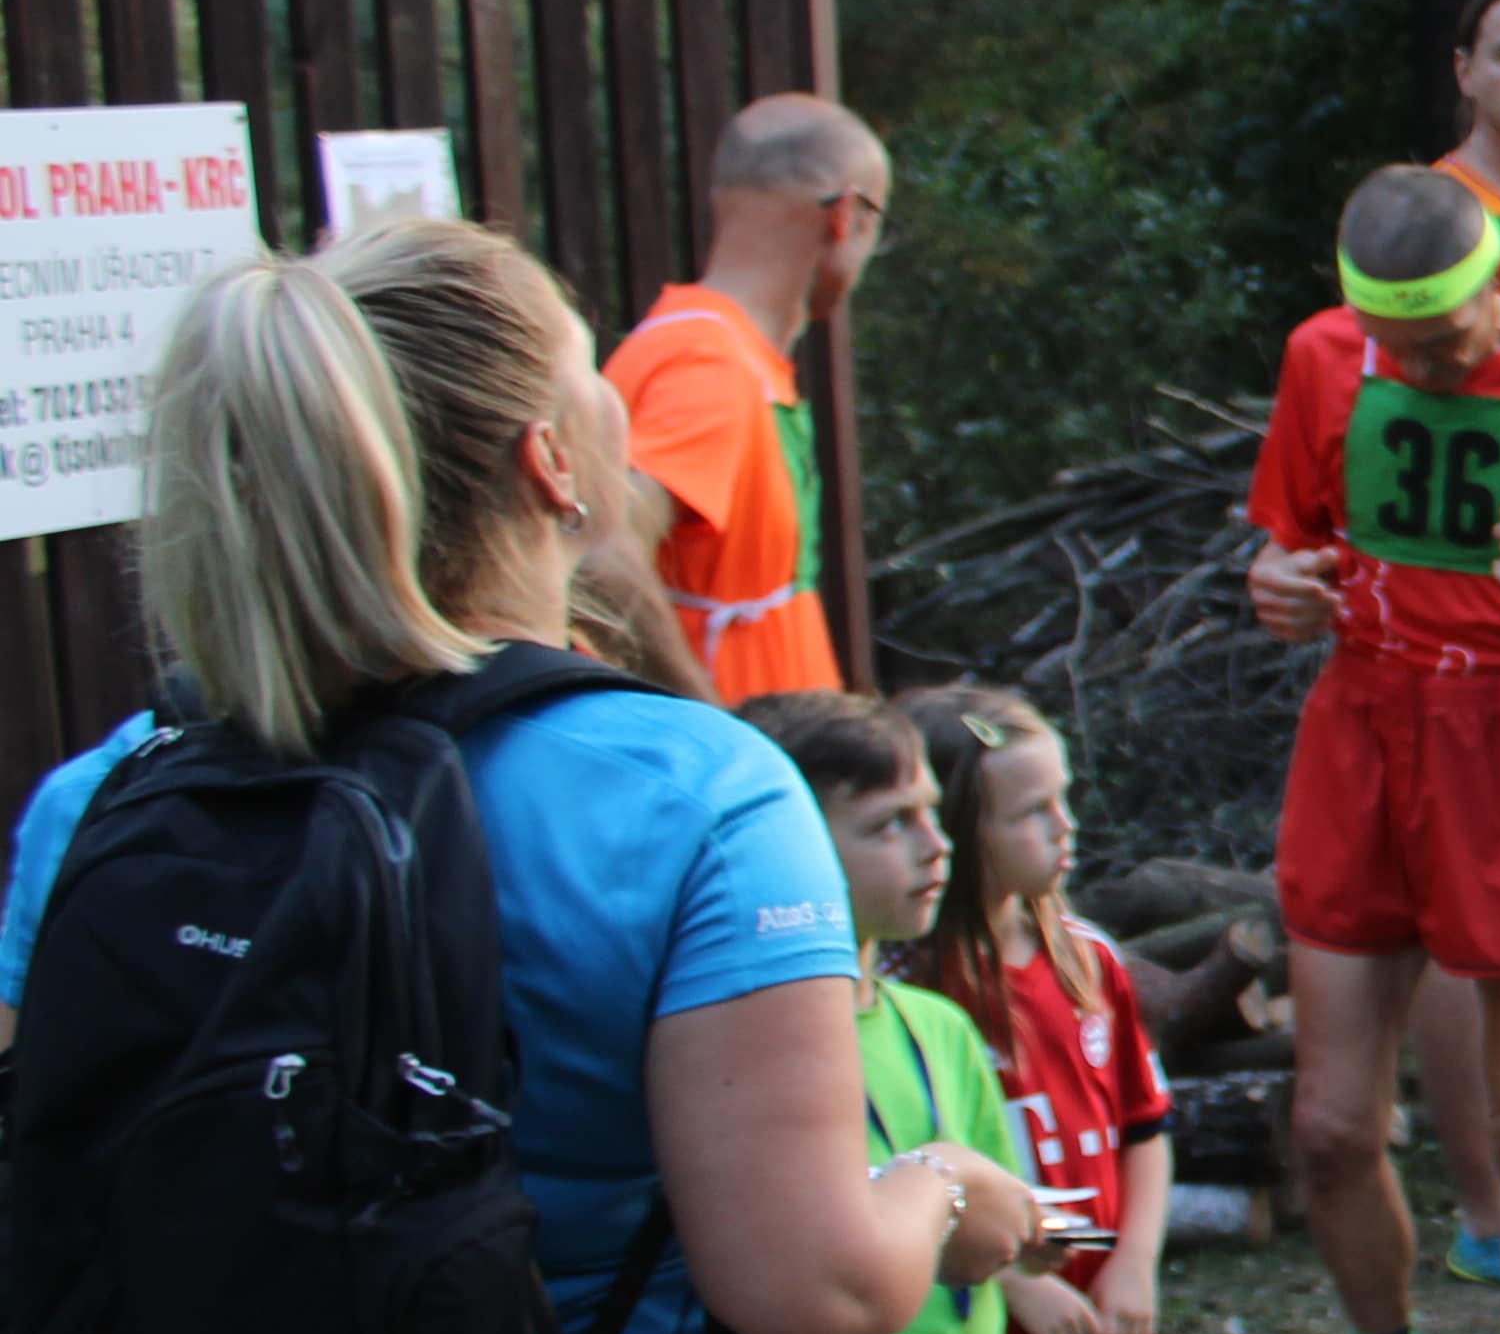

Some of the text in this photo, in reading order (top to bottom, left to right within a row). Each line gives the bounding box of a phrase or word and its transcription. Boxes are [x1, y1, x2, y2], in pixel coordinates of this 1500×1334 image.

[47, 146, 248, 217] PRAHA-KRČ
[20, 314, 114, 356] PRAHA
[18, 443, 49, 488] @
